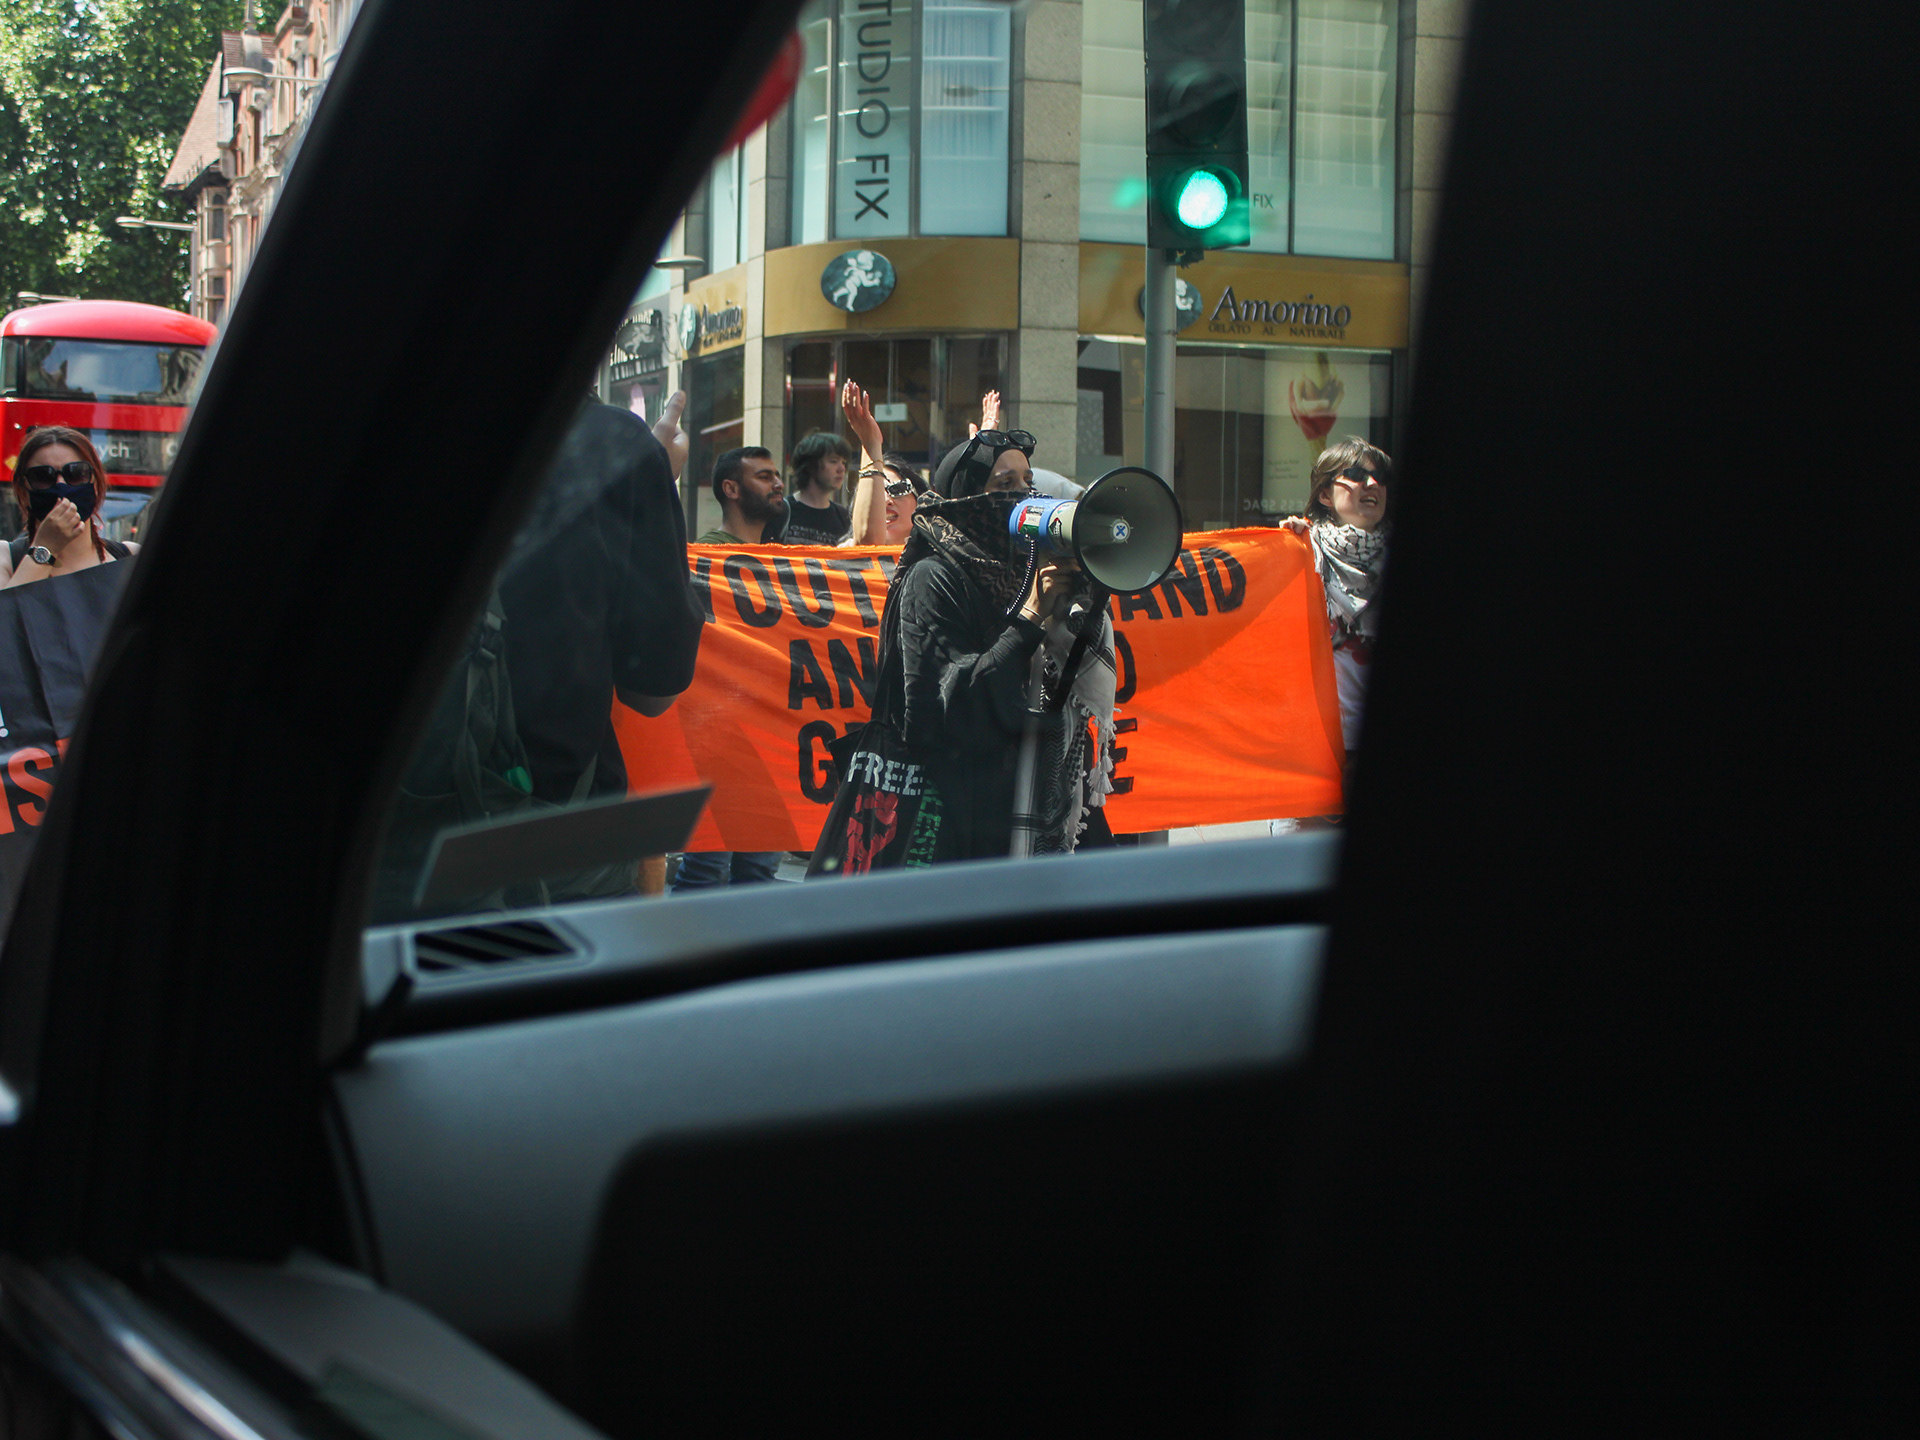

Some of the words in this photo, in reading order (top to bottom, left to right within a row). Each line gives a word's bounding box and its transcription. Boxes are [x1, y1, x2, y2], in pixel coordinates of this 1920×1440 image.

[856, 0, 892, 139] TUDIO
[855, 154, 889, 221] FIX
[1253, 194, 1274, 209] FIX
[1209, 286, 1352, 328] Amorino
[1208, 322, 1250, 335] GELATO
[1262, 325, 1276, 336] AL
[1289, 326, 1346, 340] NATURALE
[94, 441, 130, 461] ych
[847, 751, 924, 796] FREE
